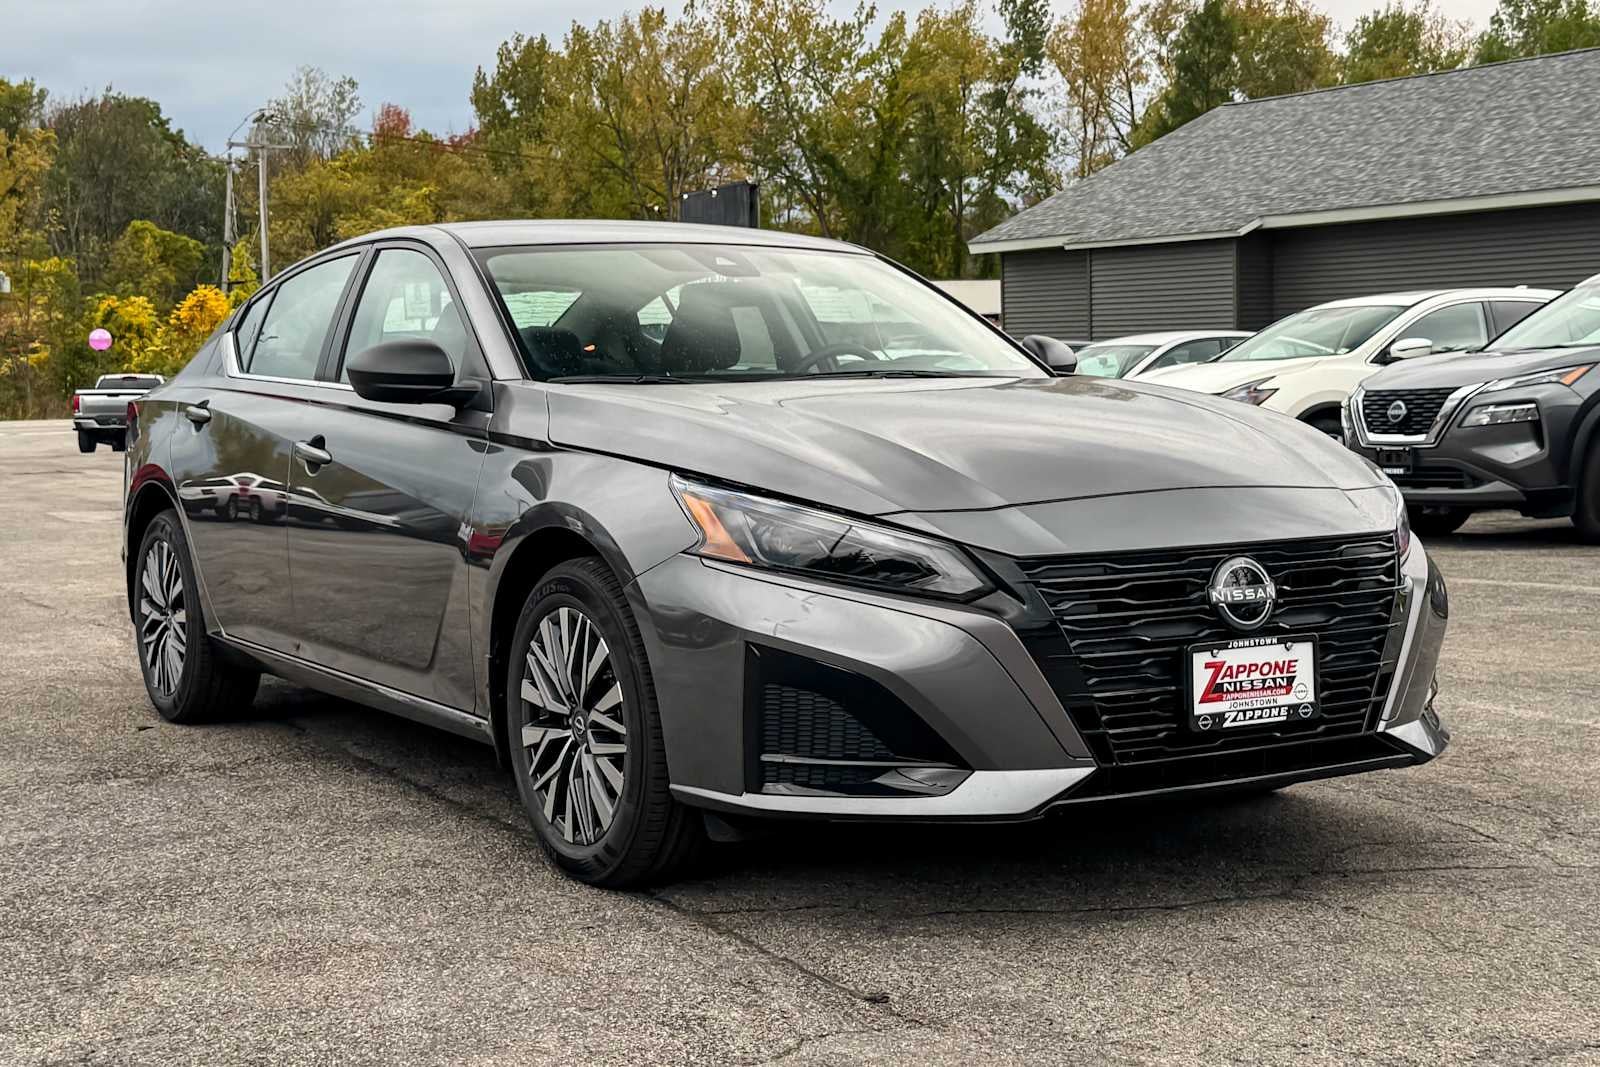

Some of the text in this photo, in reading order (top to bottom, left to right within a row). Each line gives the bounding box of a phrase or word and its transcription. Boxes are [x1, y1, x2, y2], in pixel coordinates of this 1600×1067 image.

[1212, 582, 1275, 602] NISSAN
[1228, 637, 1278, 649] JOHNSTOWN
[1199, 659, 1299, 704] ZAPPONE
[1223, 678, 1288, 692] NISSAN
[1229, 697, 1278, 709] JOHNSTOWN
[1222, 706, 1289, 728] ZAPPONE
